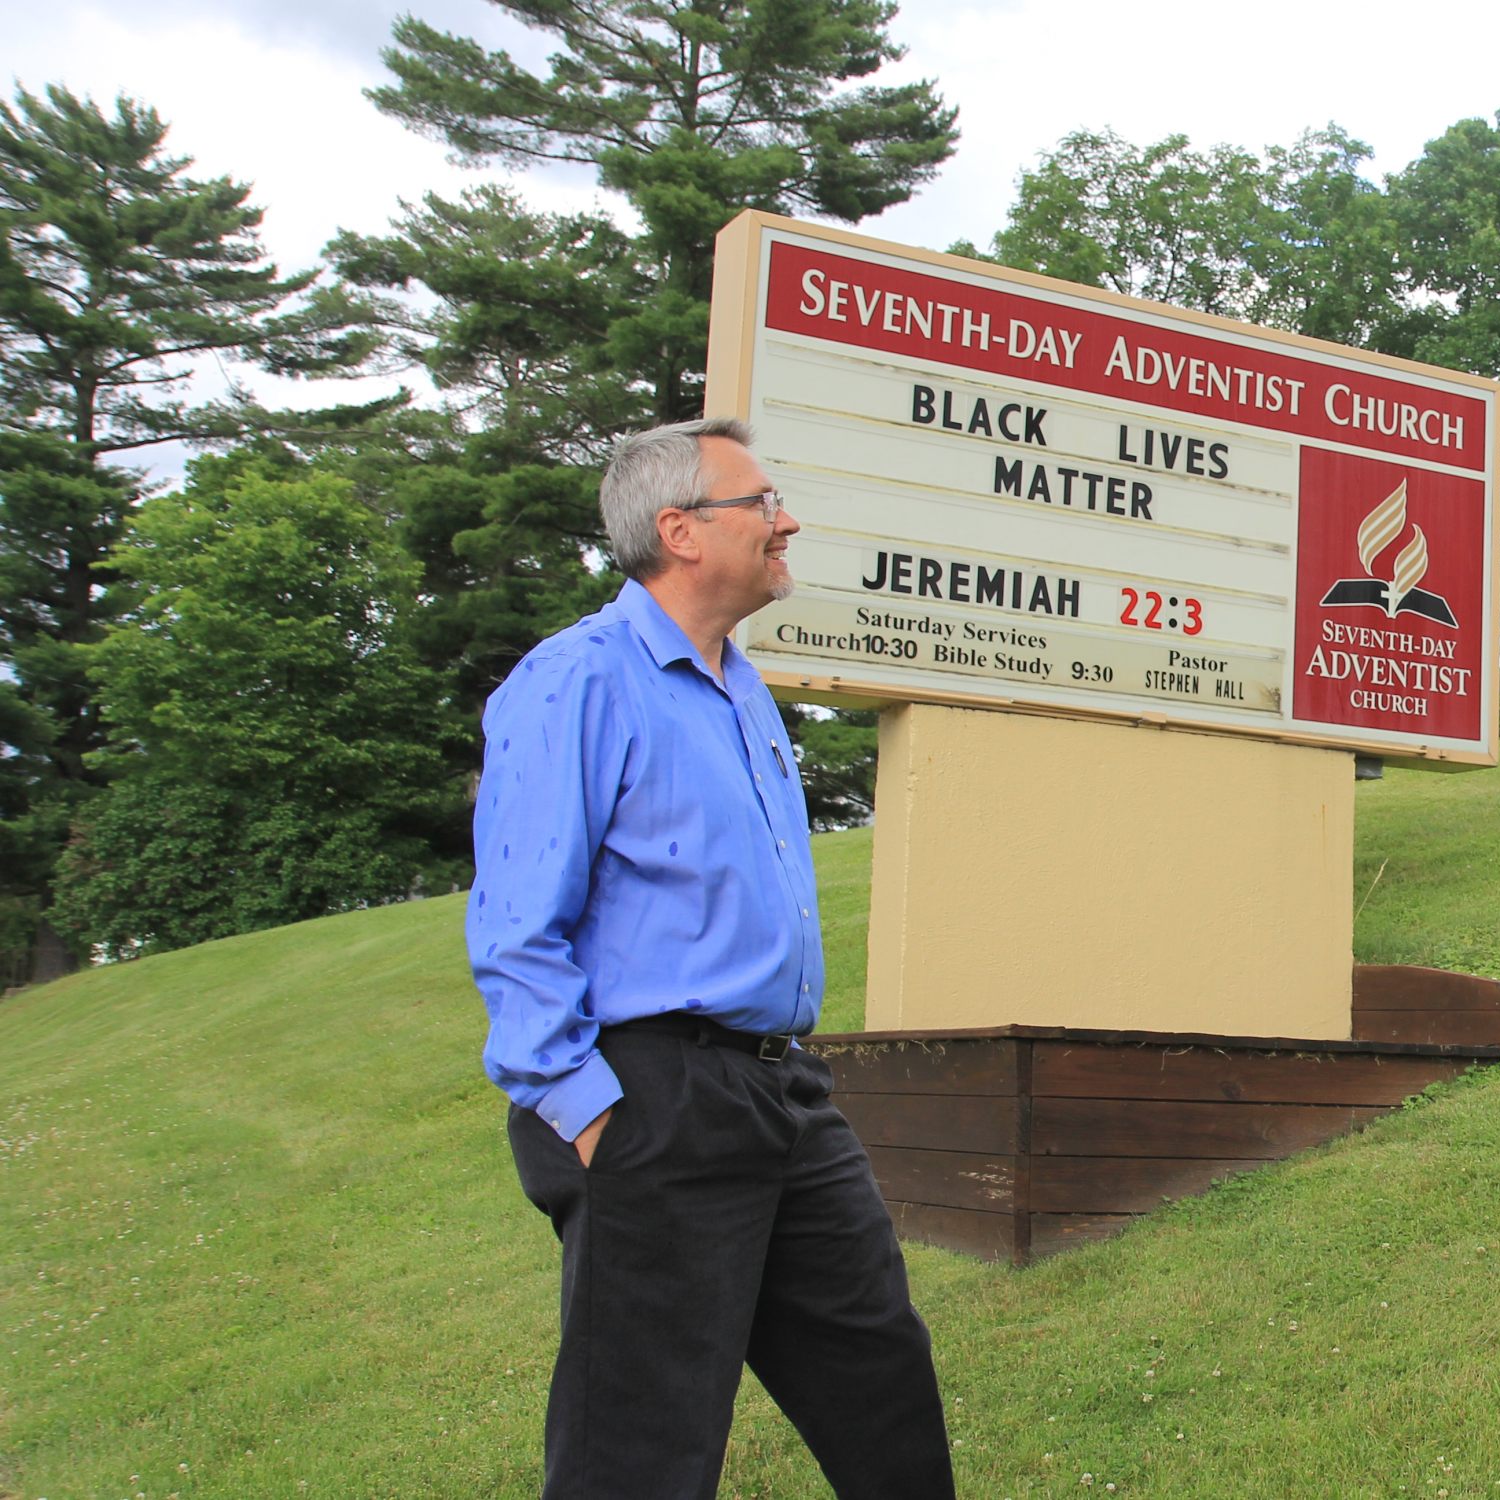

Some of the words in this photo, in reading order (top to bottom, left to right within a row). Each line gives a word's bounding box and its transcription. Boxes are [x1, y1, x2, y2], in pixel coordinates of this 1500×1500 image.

[799, 268, 1082, 369] SEVENTH-DAY
[1104, 335, 1305, 416] ADVENTIST
[1324, 383, 1464, 450] CHURCH
[912, 384, 1047, 446] BLACK
[1118, 424, 1229, 479] LIVES
[994, 455, 1153, 520] MATTER
[862, 551, 1080, 617] JEREMIAH
[1120, 587, 1203, 635] 22:3
[856, 607, 955, 640] Saturday
[963, 622, 1047, 649] Services
[1322, 619, 1457, 659] SEVENTH-DAY
[934, 644, 987, 668] Bible
[994, 653, 1053, 680] Study
[1071, 661, 1113, 683] 9:30
[1168, 650, 1228, 672] Pastor
[1305, 644, 1472, 696] ADVENTIST
[1145, 670, 1199, 694] STEPHEN
[1216, 679, 1244, 700] HALL
[1350, 689, 1428, 716] CHURCH
